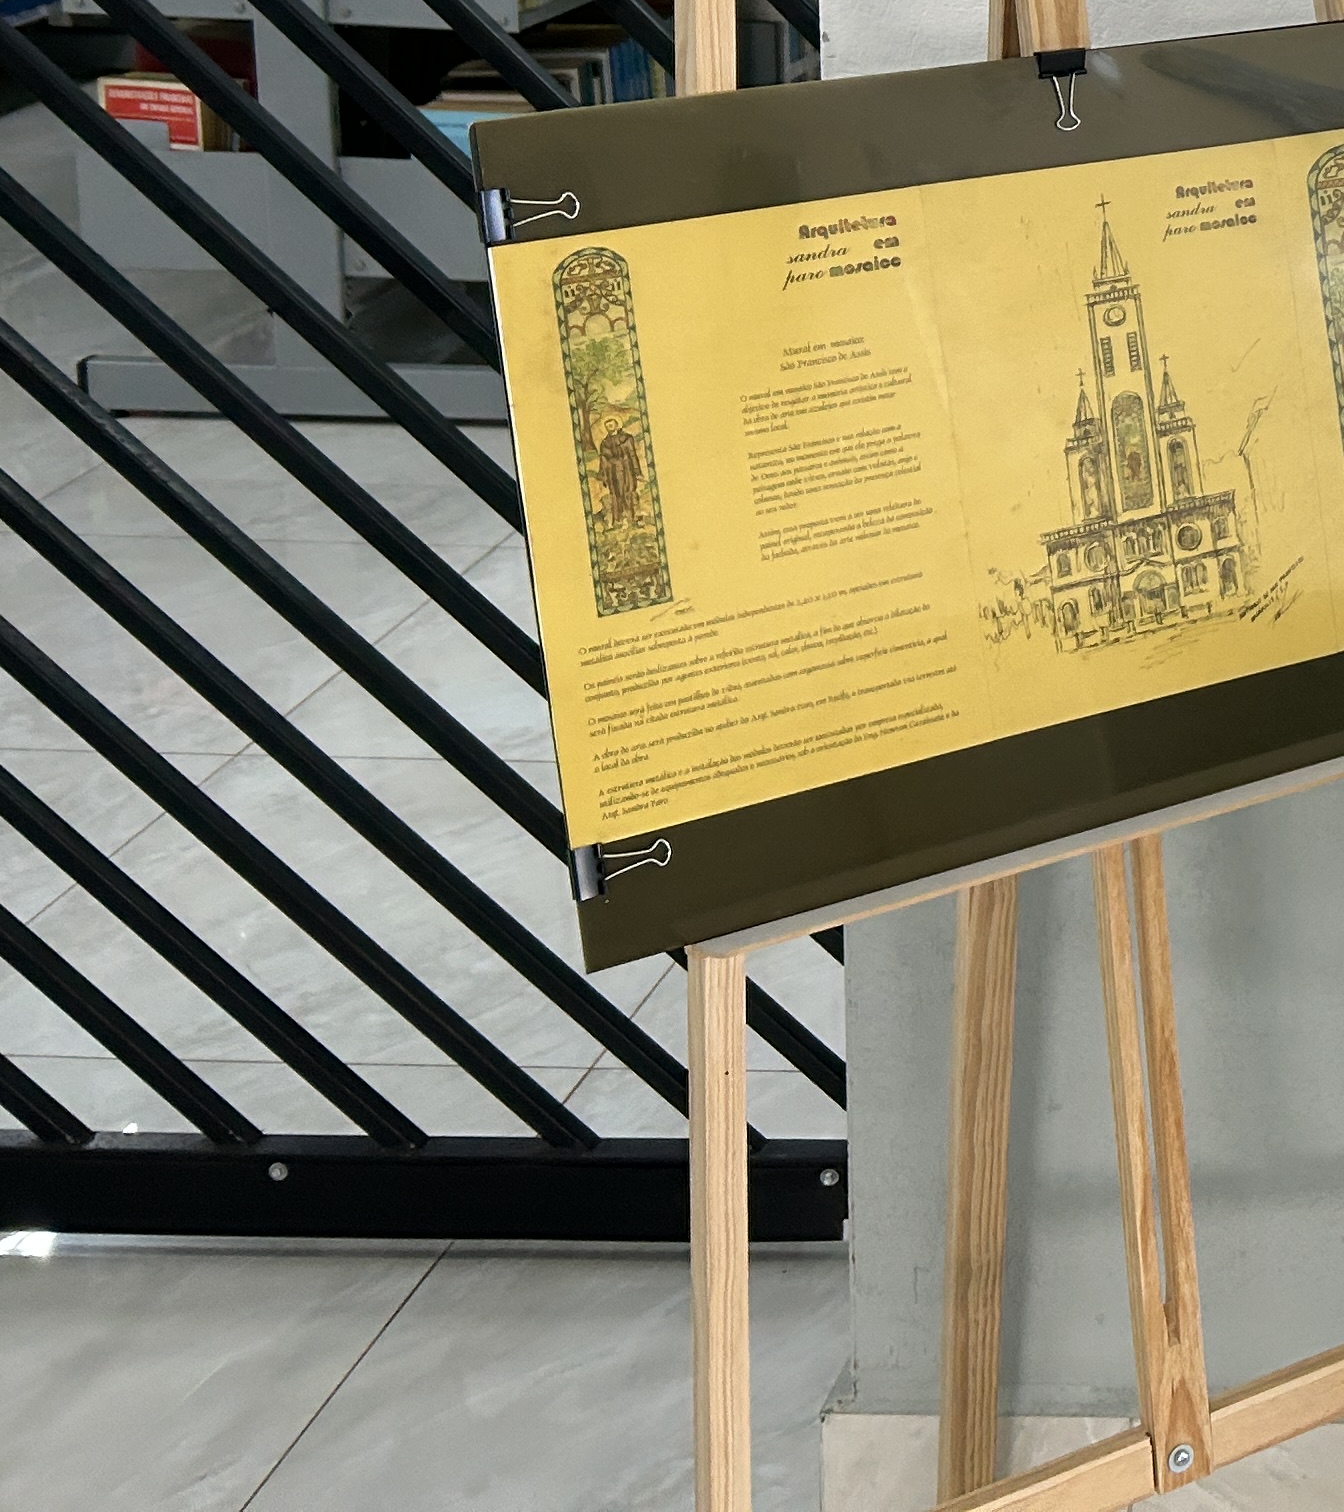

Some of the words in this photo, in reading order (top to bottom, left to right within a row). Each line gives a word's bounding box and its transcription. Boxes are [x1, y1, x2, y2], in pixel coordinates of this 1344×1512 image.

[1176, 176, 1254, 198] Arquitetura
[1166, 202, 1216, 220] sandra
[1235, 196, 1256, 208] em
[798, 214, 897, 240] Arquitetura
[873, 235, 900, 250] em
[786, 244, 848, 265] sandra
[782, 268, 825, 291] paro
[828, 255, 902, 278] mosaico
